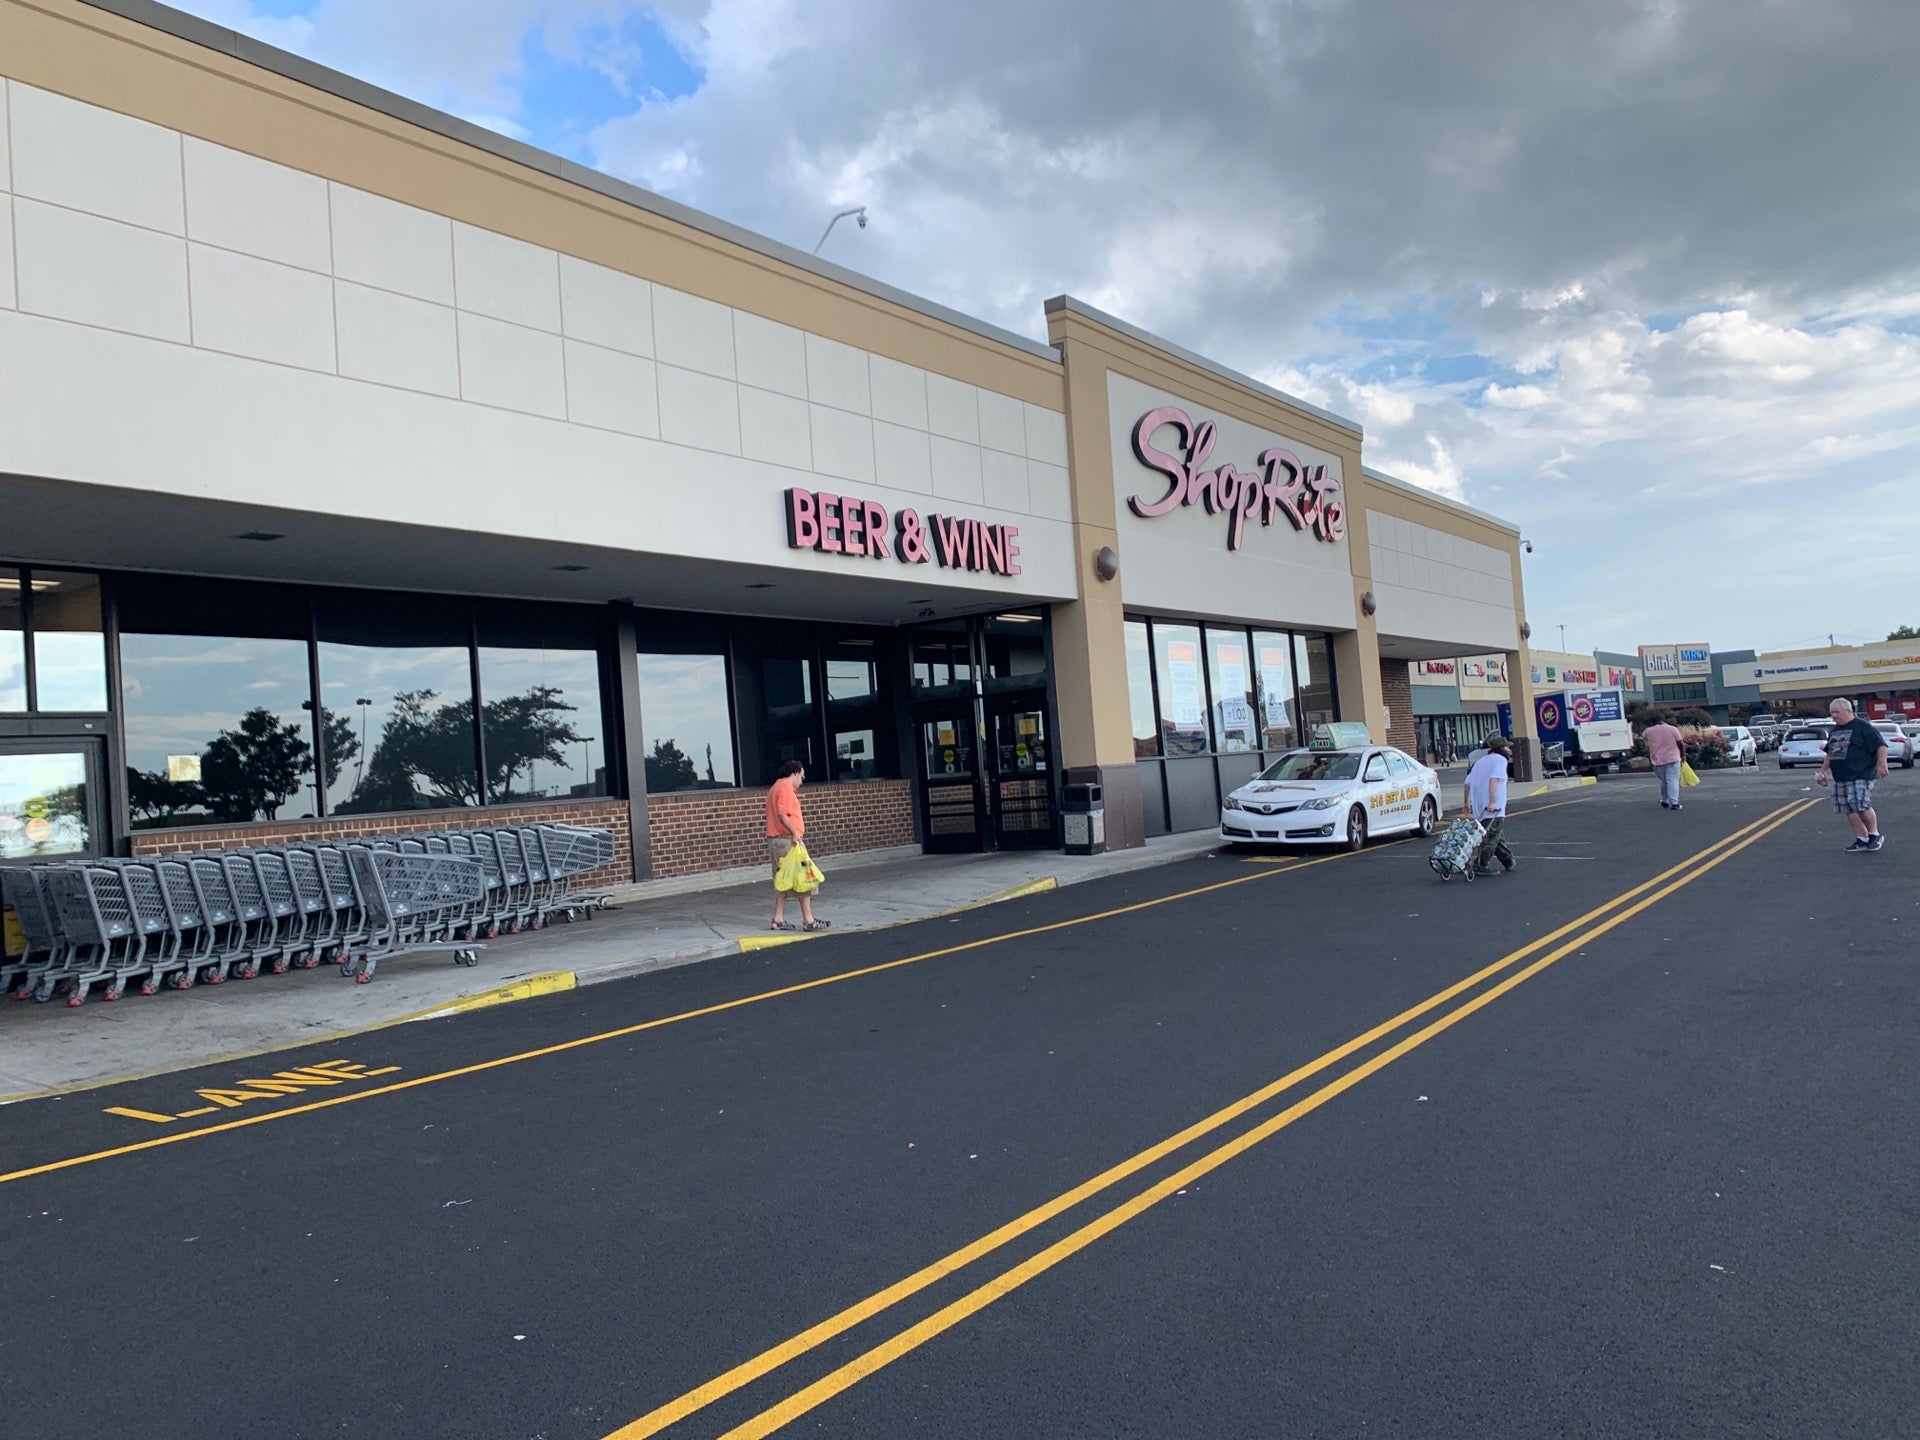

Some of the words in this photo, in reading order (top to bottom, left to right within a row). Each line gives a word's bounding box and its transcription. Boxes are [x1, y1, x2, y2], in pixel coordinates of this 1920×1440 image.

[1128, 406, 1346, 551] ShopRite
[785, 487, 891, 559] BEER
[894, 508, 931, 564] &
[928, 513, 1022, 576] WINE
[1645, 654, 1674, 671] blink
[1385, 791, 1398, 805] GET
[1400, 789, 1405, 801] A
[1406, 786, 1419, 799] CAB
[102, 1059, 402, 1123] LANE
